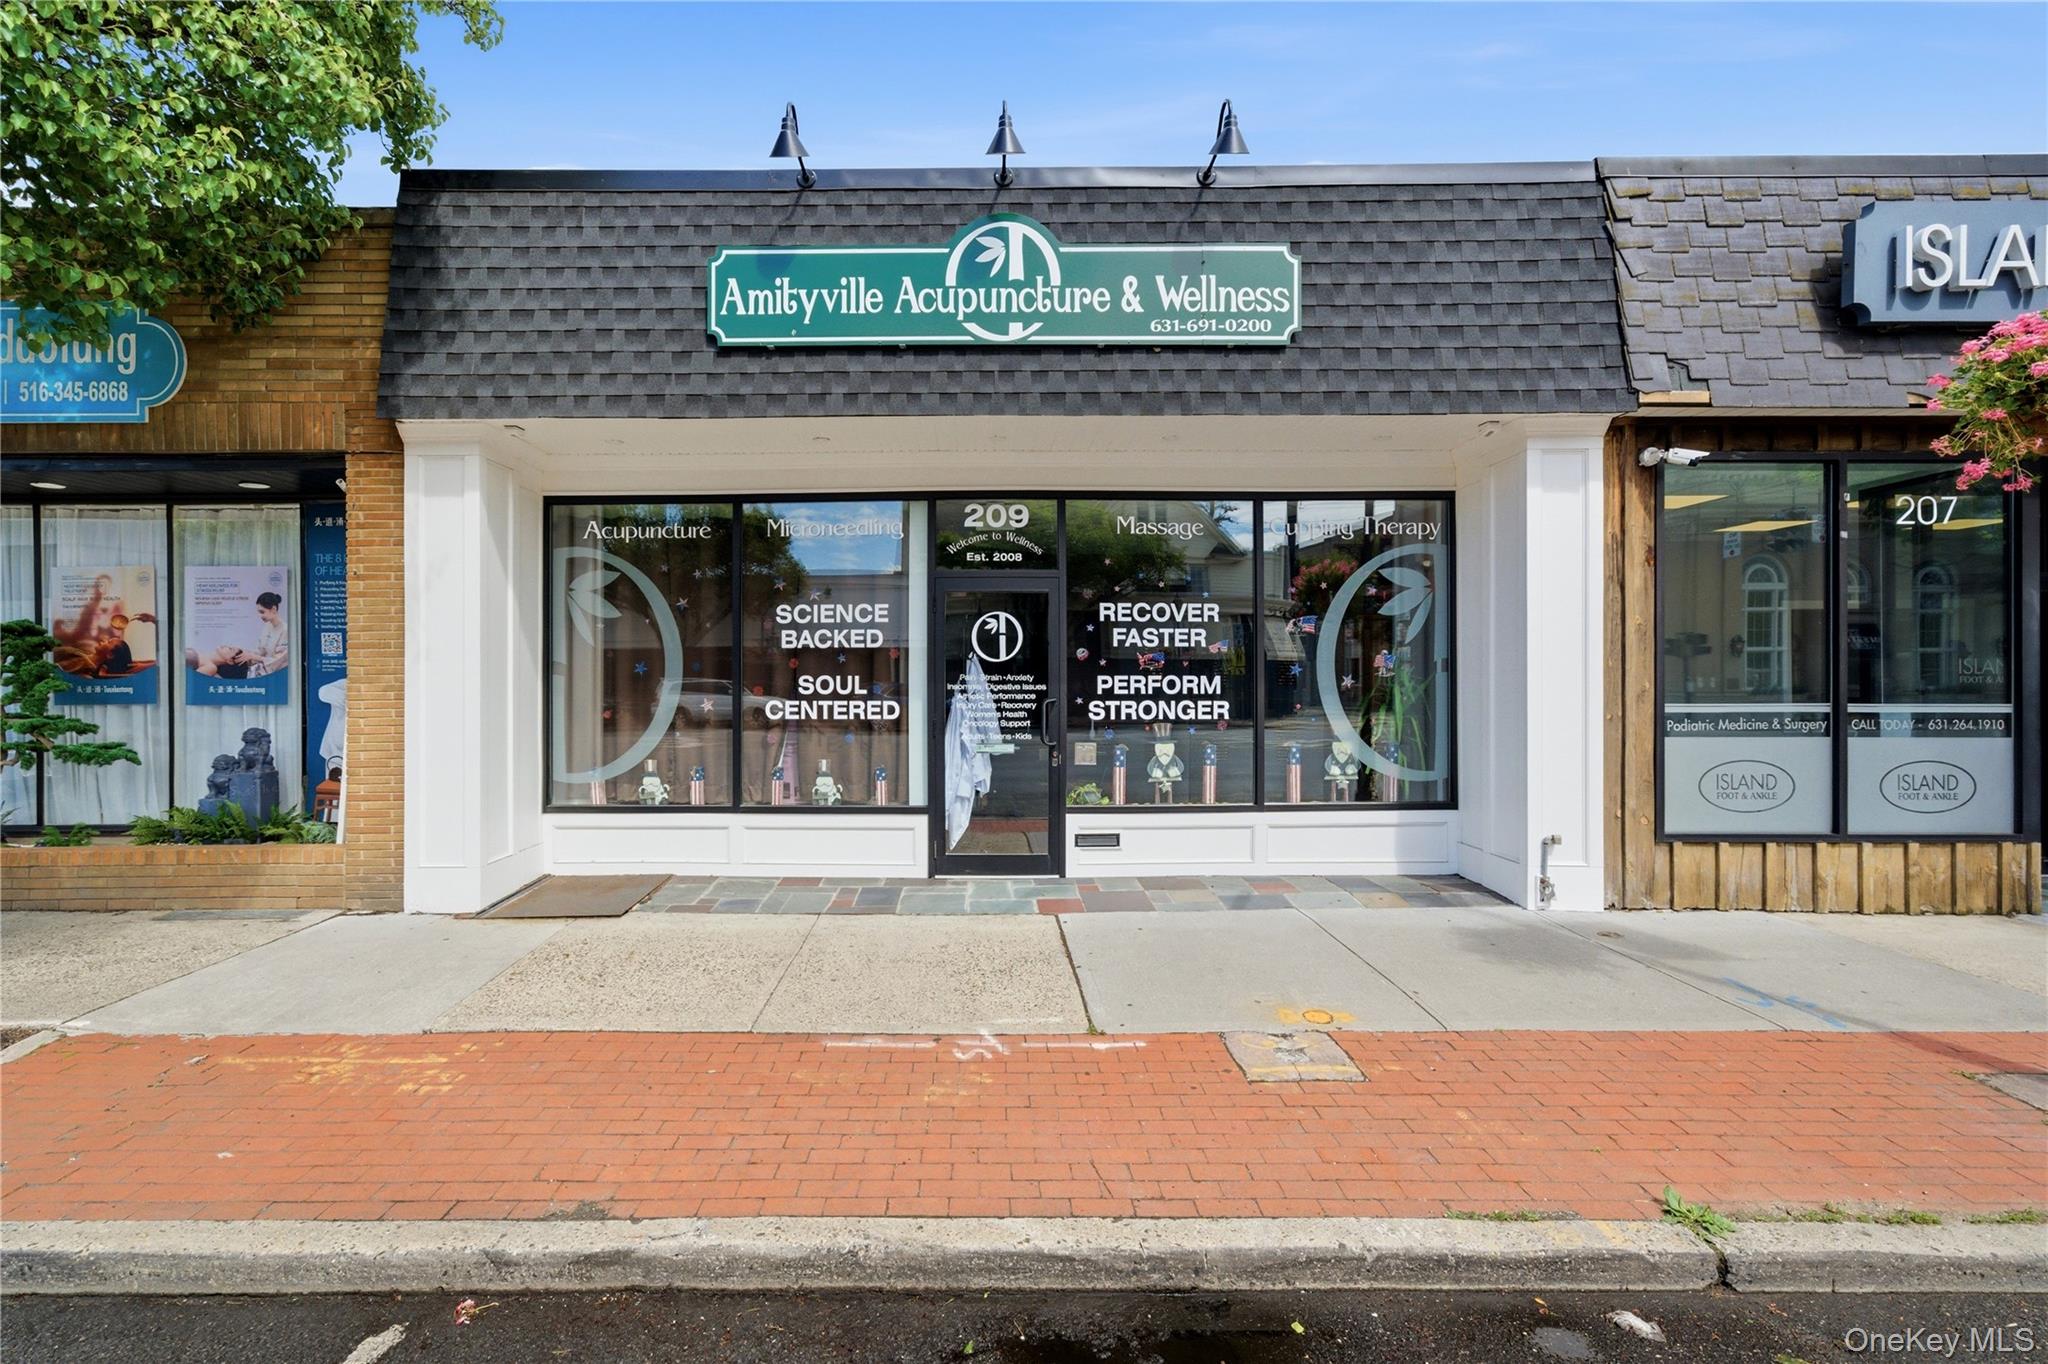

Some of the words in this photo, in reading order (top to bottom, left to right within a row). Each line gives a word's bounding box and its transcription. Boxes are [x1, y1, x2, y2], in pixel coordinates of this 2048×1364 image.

[1906, 223, 2048, 288] ISLA
[720, 276, 884, 323] Amityville
[895, 275, 1112, 321] Acupuncture
[1121, 278, 1144, 313] &
[1156, 275, 1291, 313] Wellness
[1150, 318, 1273, 333] 631-691-0200
[19, 381, 128, 402] 516-345-6868
[963, 503, 1030, 528] 209
[1896, 496, 1958, 525] 207
[583, 520, 712, 543] Acupuncture
[766, 518, 904, 541] Microneedling
[1116, 515, 1204, 539] Massage
[1362, 516, 1442, 540] Therapy
[946, 533, 989, 554] Welcome
[992, 532, 1001, 540] to
[1006, 531, 1044, 555] Wellness
[966, 552, 989, 561] Est.
[993, 553, 1023, 561] 2008
[776, 604, 889, 624] SCIENCE
[1099, 603, 1220, 623] RECOVER
[781, 629, 884, 649] BACKED
[1112, 628, 1207, 648] FASTER
[798, 675, 868, 695] SOUL
[986, 683, 1021, 691] Digestive
[1006, 674, 1034, 682] Anxiety
[1096, 675, 1222, 695] PERFORM
[765, 700, 901, 720] CENTERED
[1001, 702, 1037, 710] Recovery
[1088, 700, 1230, 721] STRONGER
[1000, 720, 1031, 728] Support
[1666, 718, 1715, 732] Podiatric
[1718, 718, 1770, 731] Medicine
[1773, 718, 1781, 730] &
[1784, 718, 1828, 733] Surgery
[1851, 719, 1876, 730] CALL
[1879, 719, 1914, 730] TODAY
[1928, 719, 2005, 731] 631.264.1910
[1715, 773, 1777, 791] ISLAND
[1896, 773, 1959, 791] ISLAND
[1716, 792, 1740, 800] FOOT
[1742, 792, 1748, 800] &
[1750, 792, 1777, 800] ANKLE
[1897, 792, 1921, 800] FOOT
[1923, 792, 1930, 800] &
[1931, 792, 1959, 800] ANKLE
